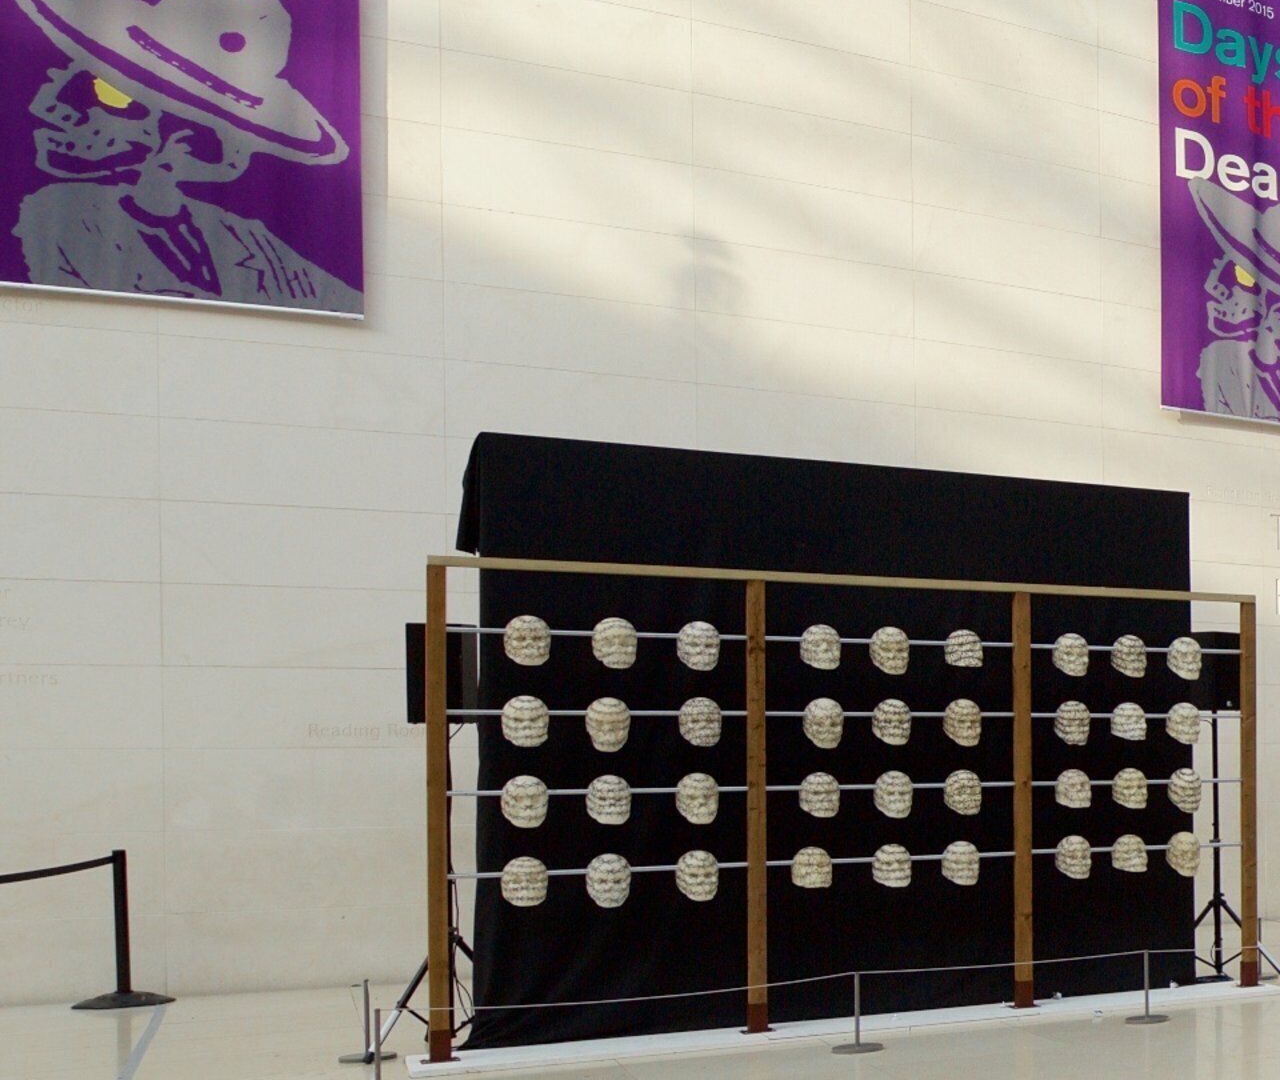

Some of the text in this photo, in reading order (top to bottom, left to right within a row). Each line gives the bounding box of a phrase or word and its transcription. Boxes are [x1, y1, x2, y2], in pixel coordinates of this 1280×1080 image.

[1249, 0, 1274, 19] 2015
[1172, 75, 1226, 124] of
[308, 723, 427, 740] Reading Roo
